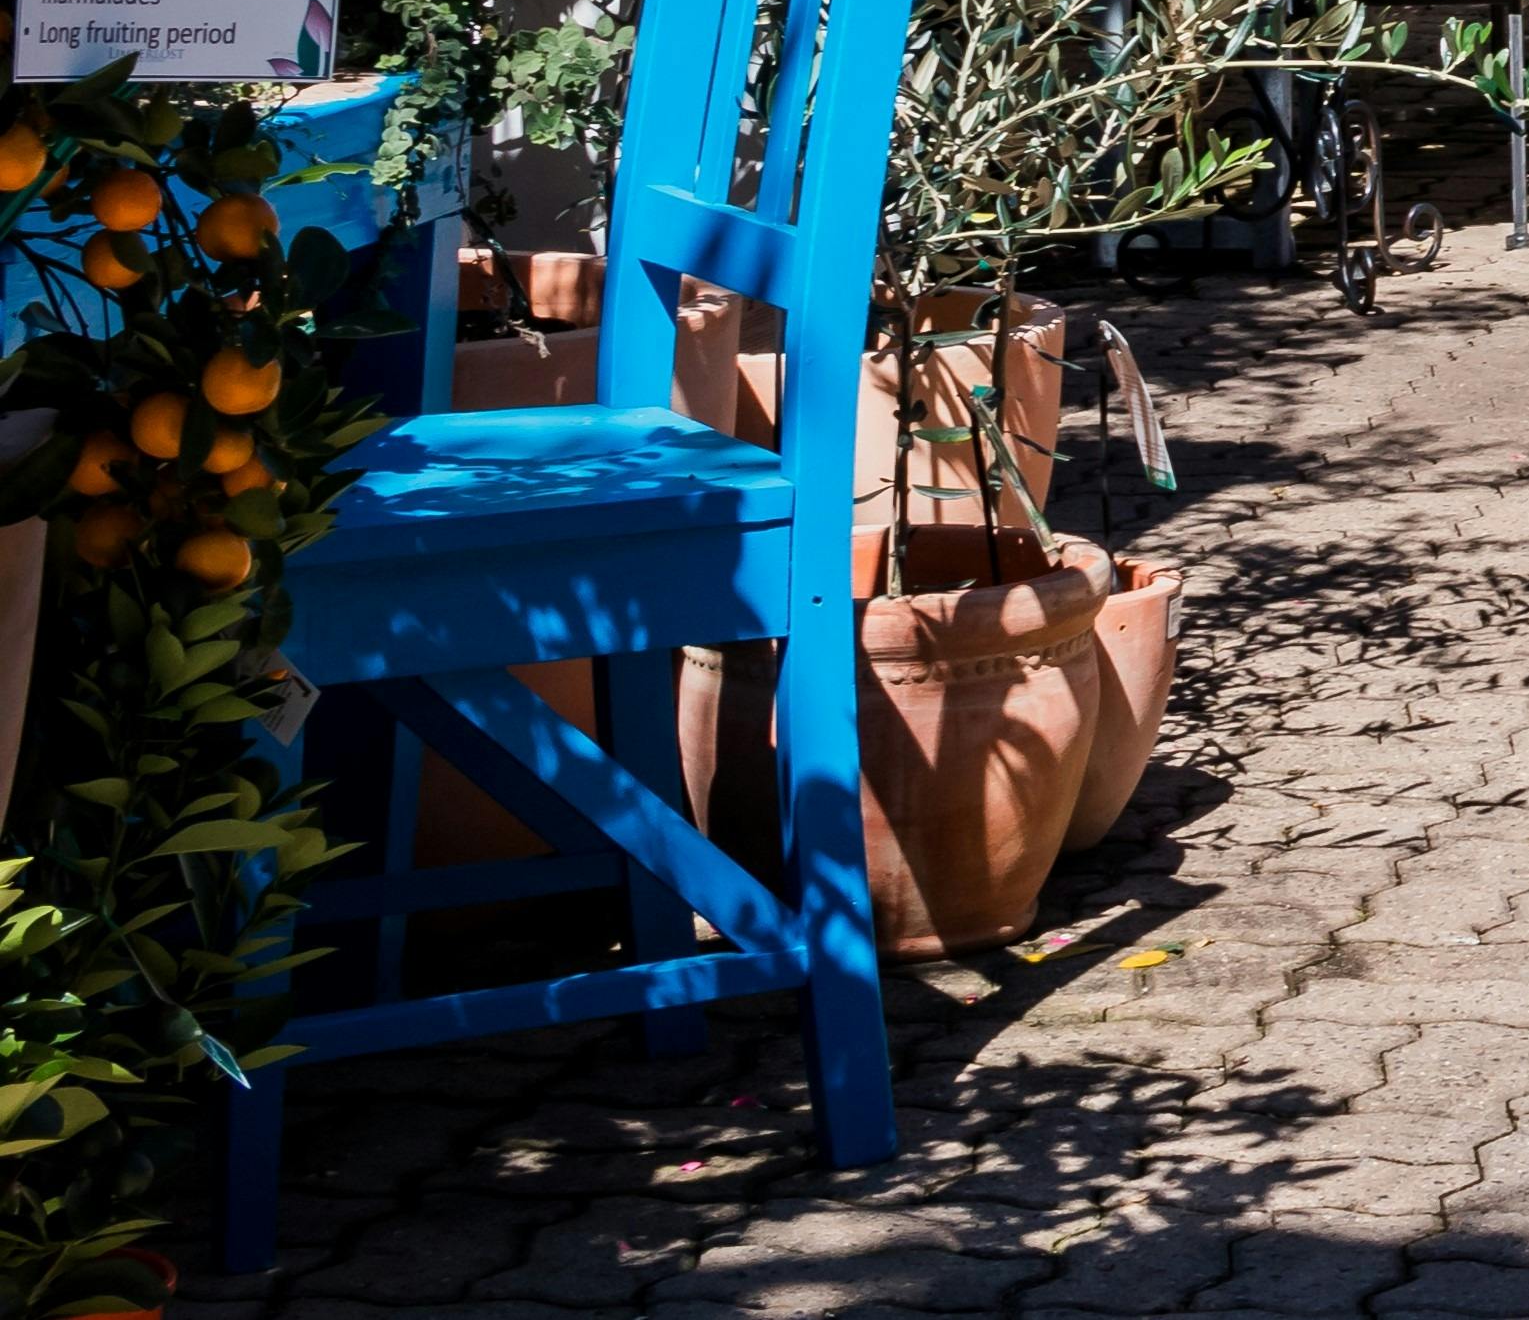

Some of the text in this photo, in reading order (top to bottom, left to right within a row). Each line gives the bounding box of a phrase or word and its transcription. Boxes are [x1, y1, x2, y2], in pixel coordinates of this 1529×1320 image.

[39, 20, 236, 49] Long fruiting period
